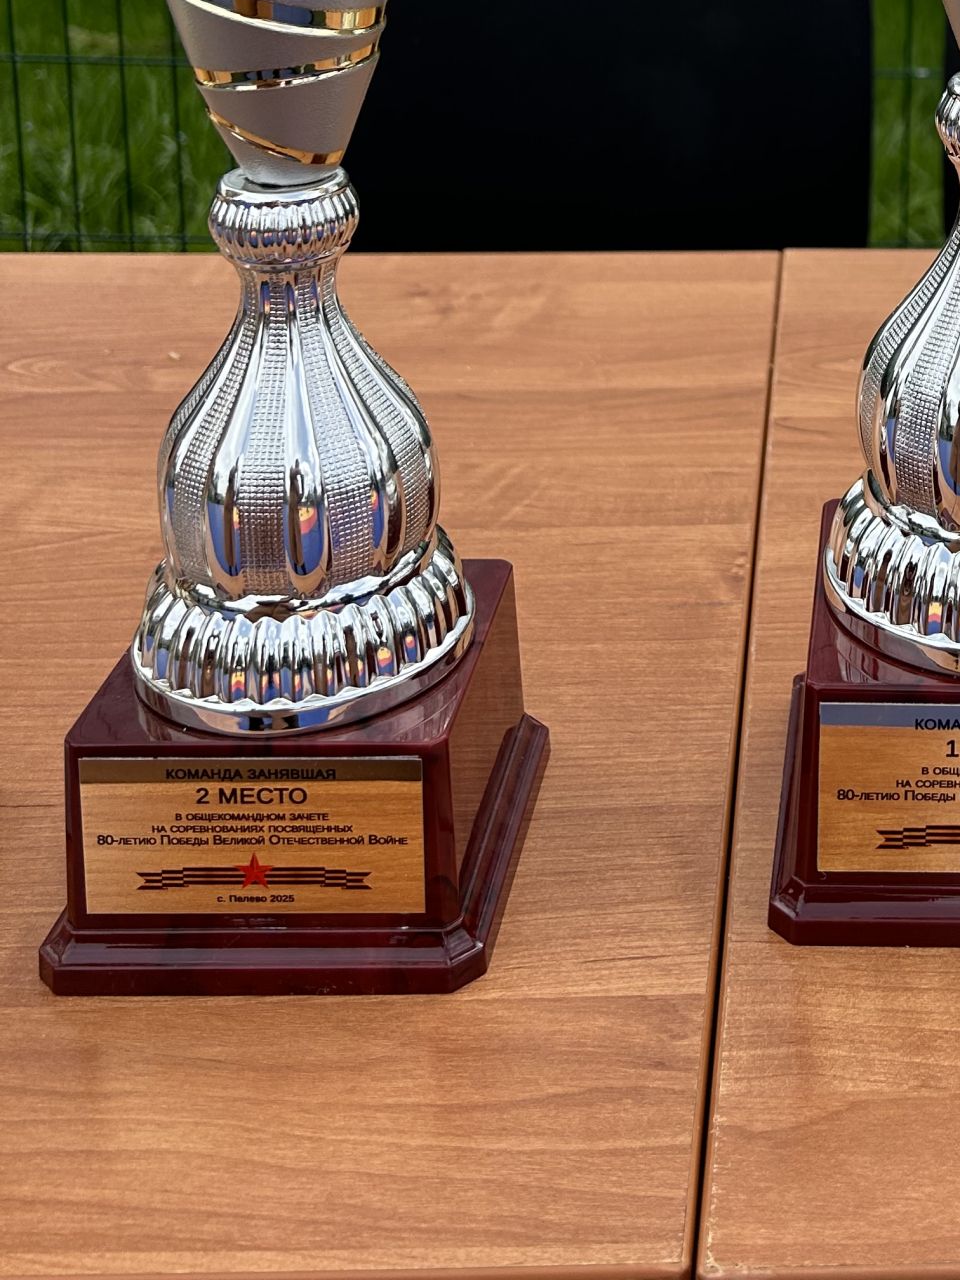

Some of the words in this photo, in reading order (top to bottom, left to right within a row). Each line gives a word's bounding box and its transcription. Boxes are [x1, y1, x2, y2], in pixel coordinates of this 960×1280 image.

[946, 740, 959, 758] 1
[166, 769, 243, 781] КОМАНДА
[247, 769, 336, 780] ЗАНЯВШАЯ
[196, 788, 209, 805] 2
[219, 788, 307, 804] МЕСТО
